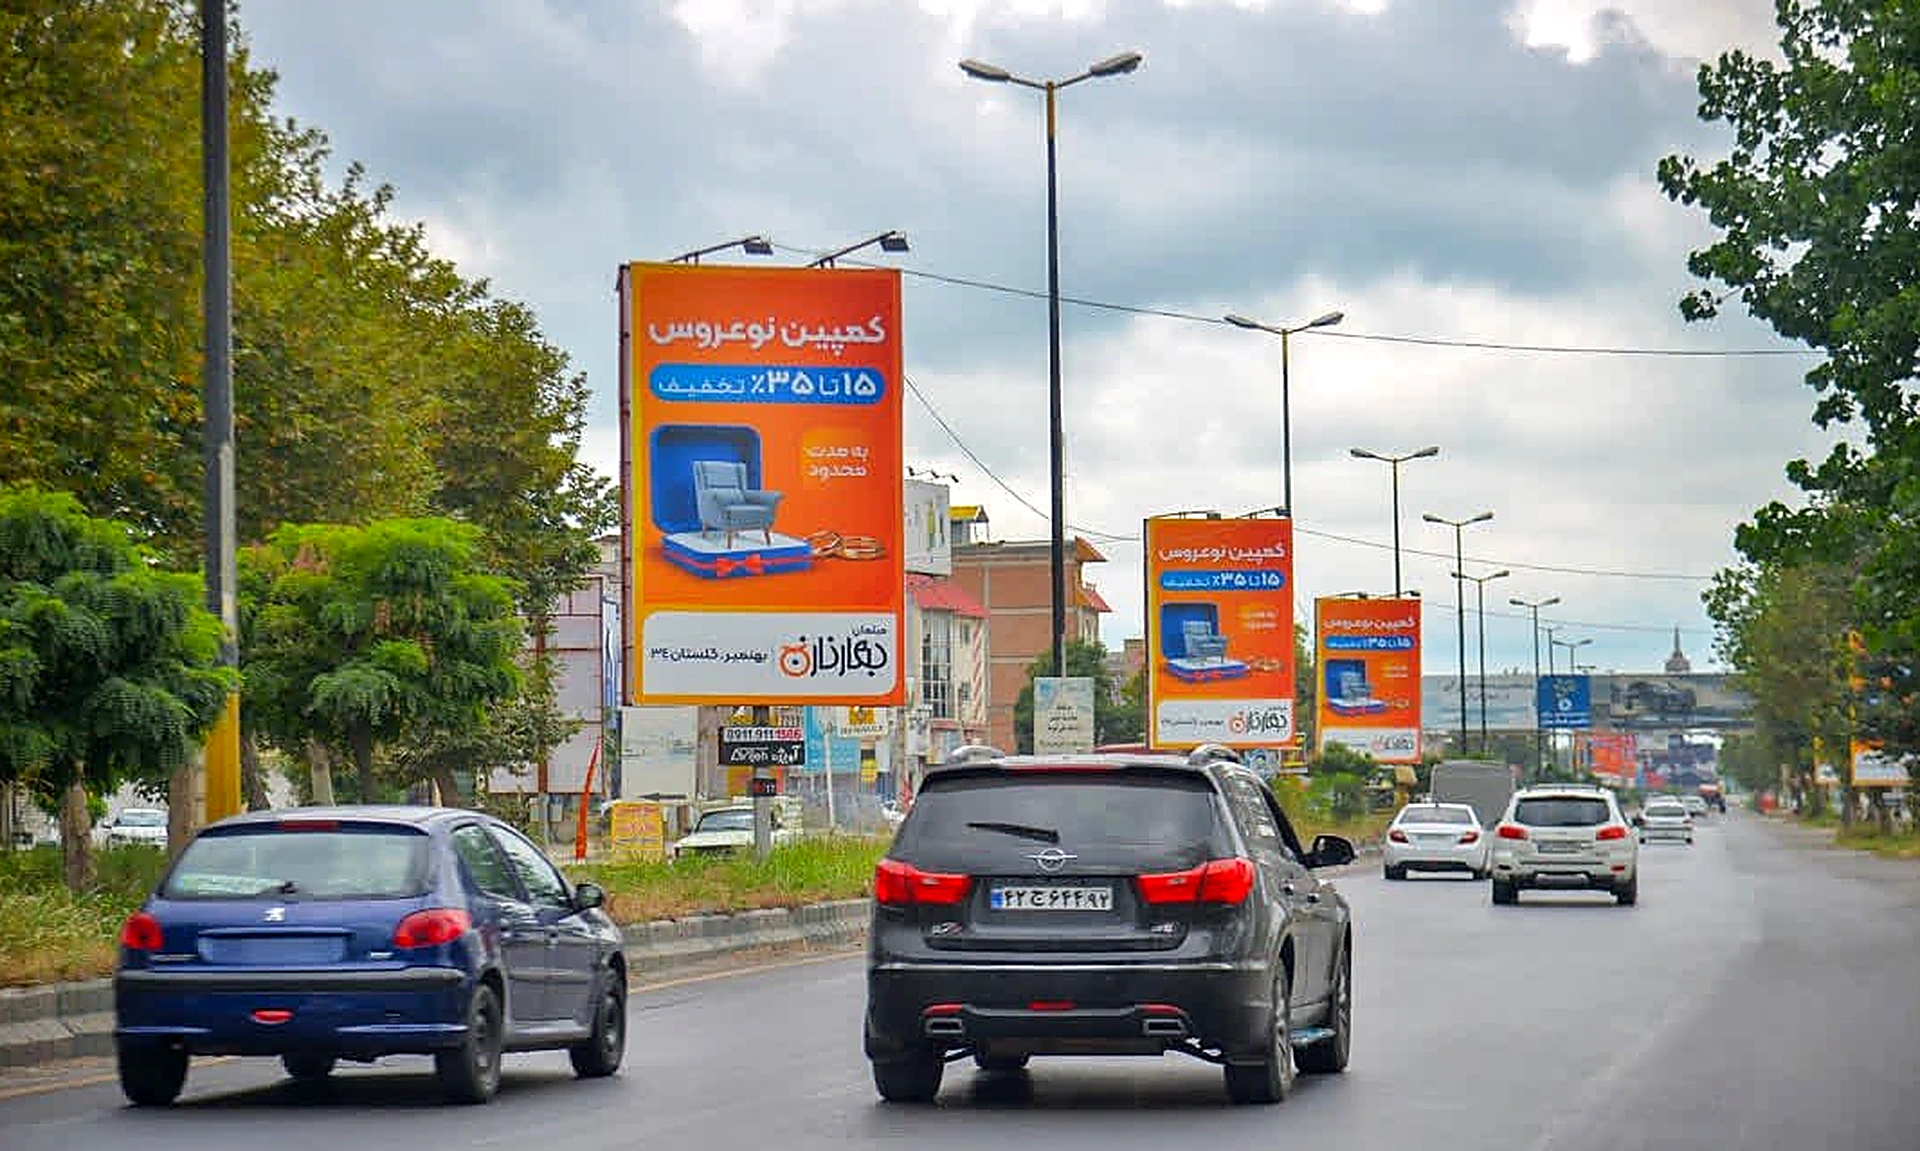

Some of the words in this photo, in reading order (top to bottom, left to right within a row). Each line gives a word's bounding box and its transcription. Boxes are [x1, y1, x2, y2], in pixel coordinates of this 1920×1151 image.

[648, 316, 776, 349] نوعروس
[781, 316, 886, 356] کمپین
[658, 377, 746, 397] تخفیف
[819, 373, 842, 396] تا
[844, 371, 877, 396] ۱۵
[850, 445, 869, 462] به
[808, 465, 868, 482] محدود
